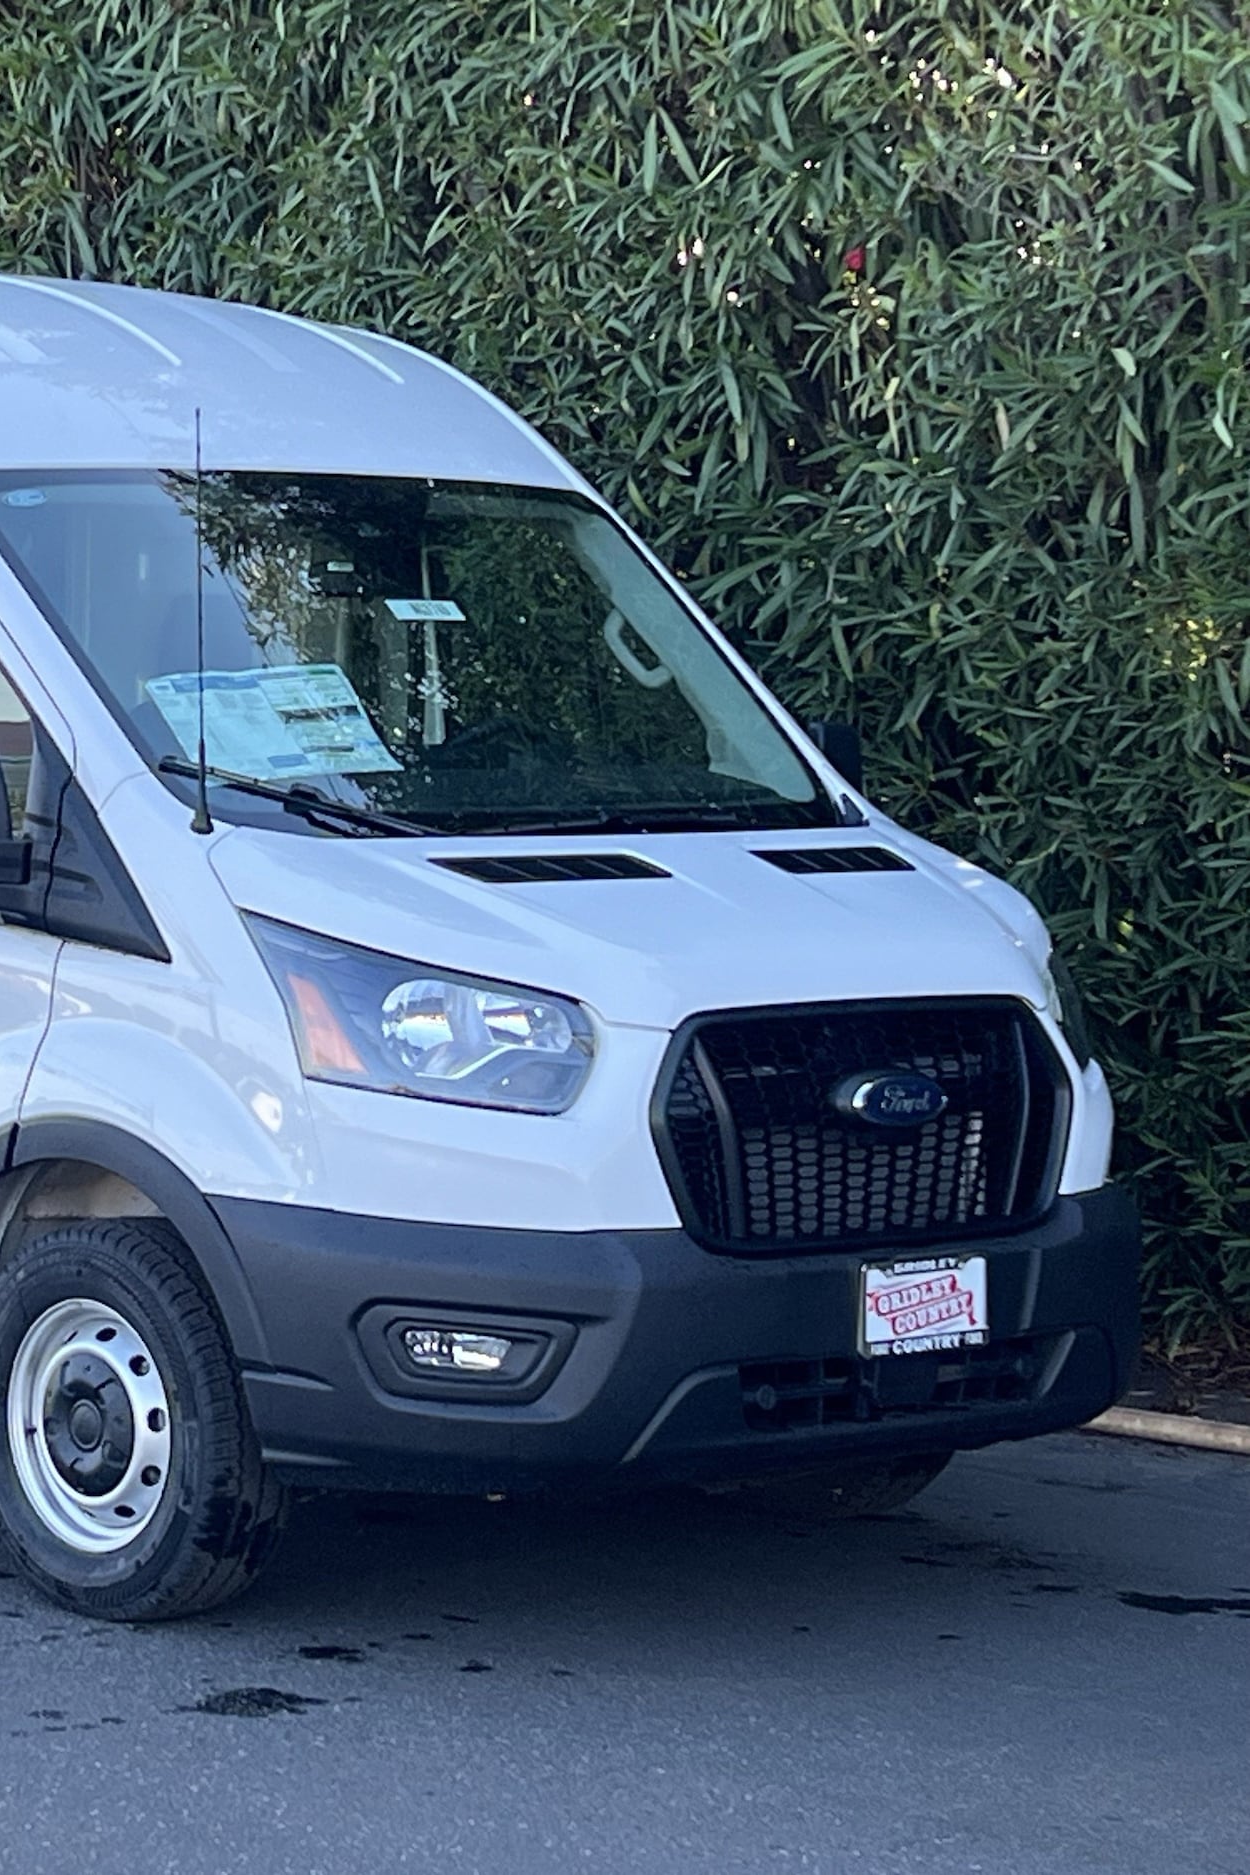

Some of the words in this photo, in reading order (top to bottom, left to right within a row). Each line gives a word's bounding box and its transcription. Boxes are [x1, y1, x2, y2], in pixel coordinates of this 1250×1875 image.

[880, 1084, 931, 1113] Ford
[876, 1278, 954, 1315] GRIDLEY
[893, 1293, 971, 1334] COUNTRY
[892, 1333, 961, 1356] COUNTRY
